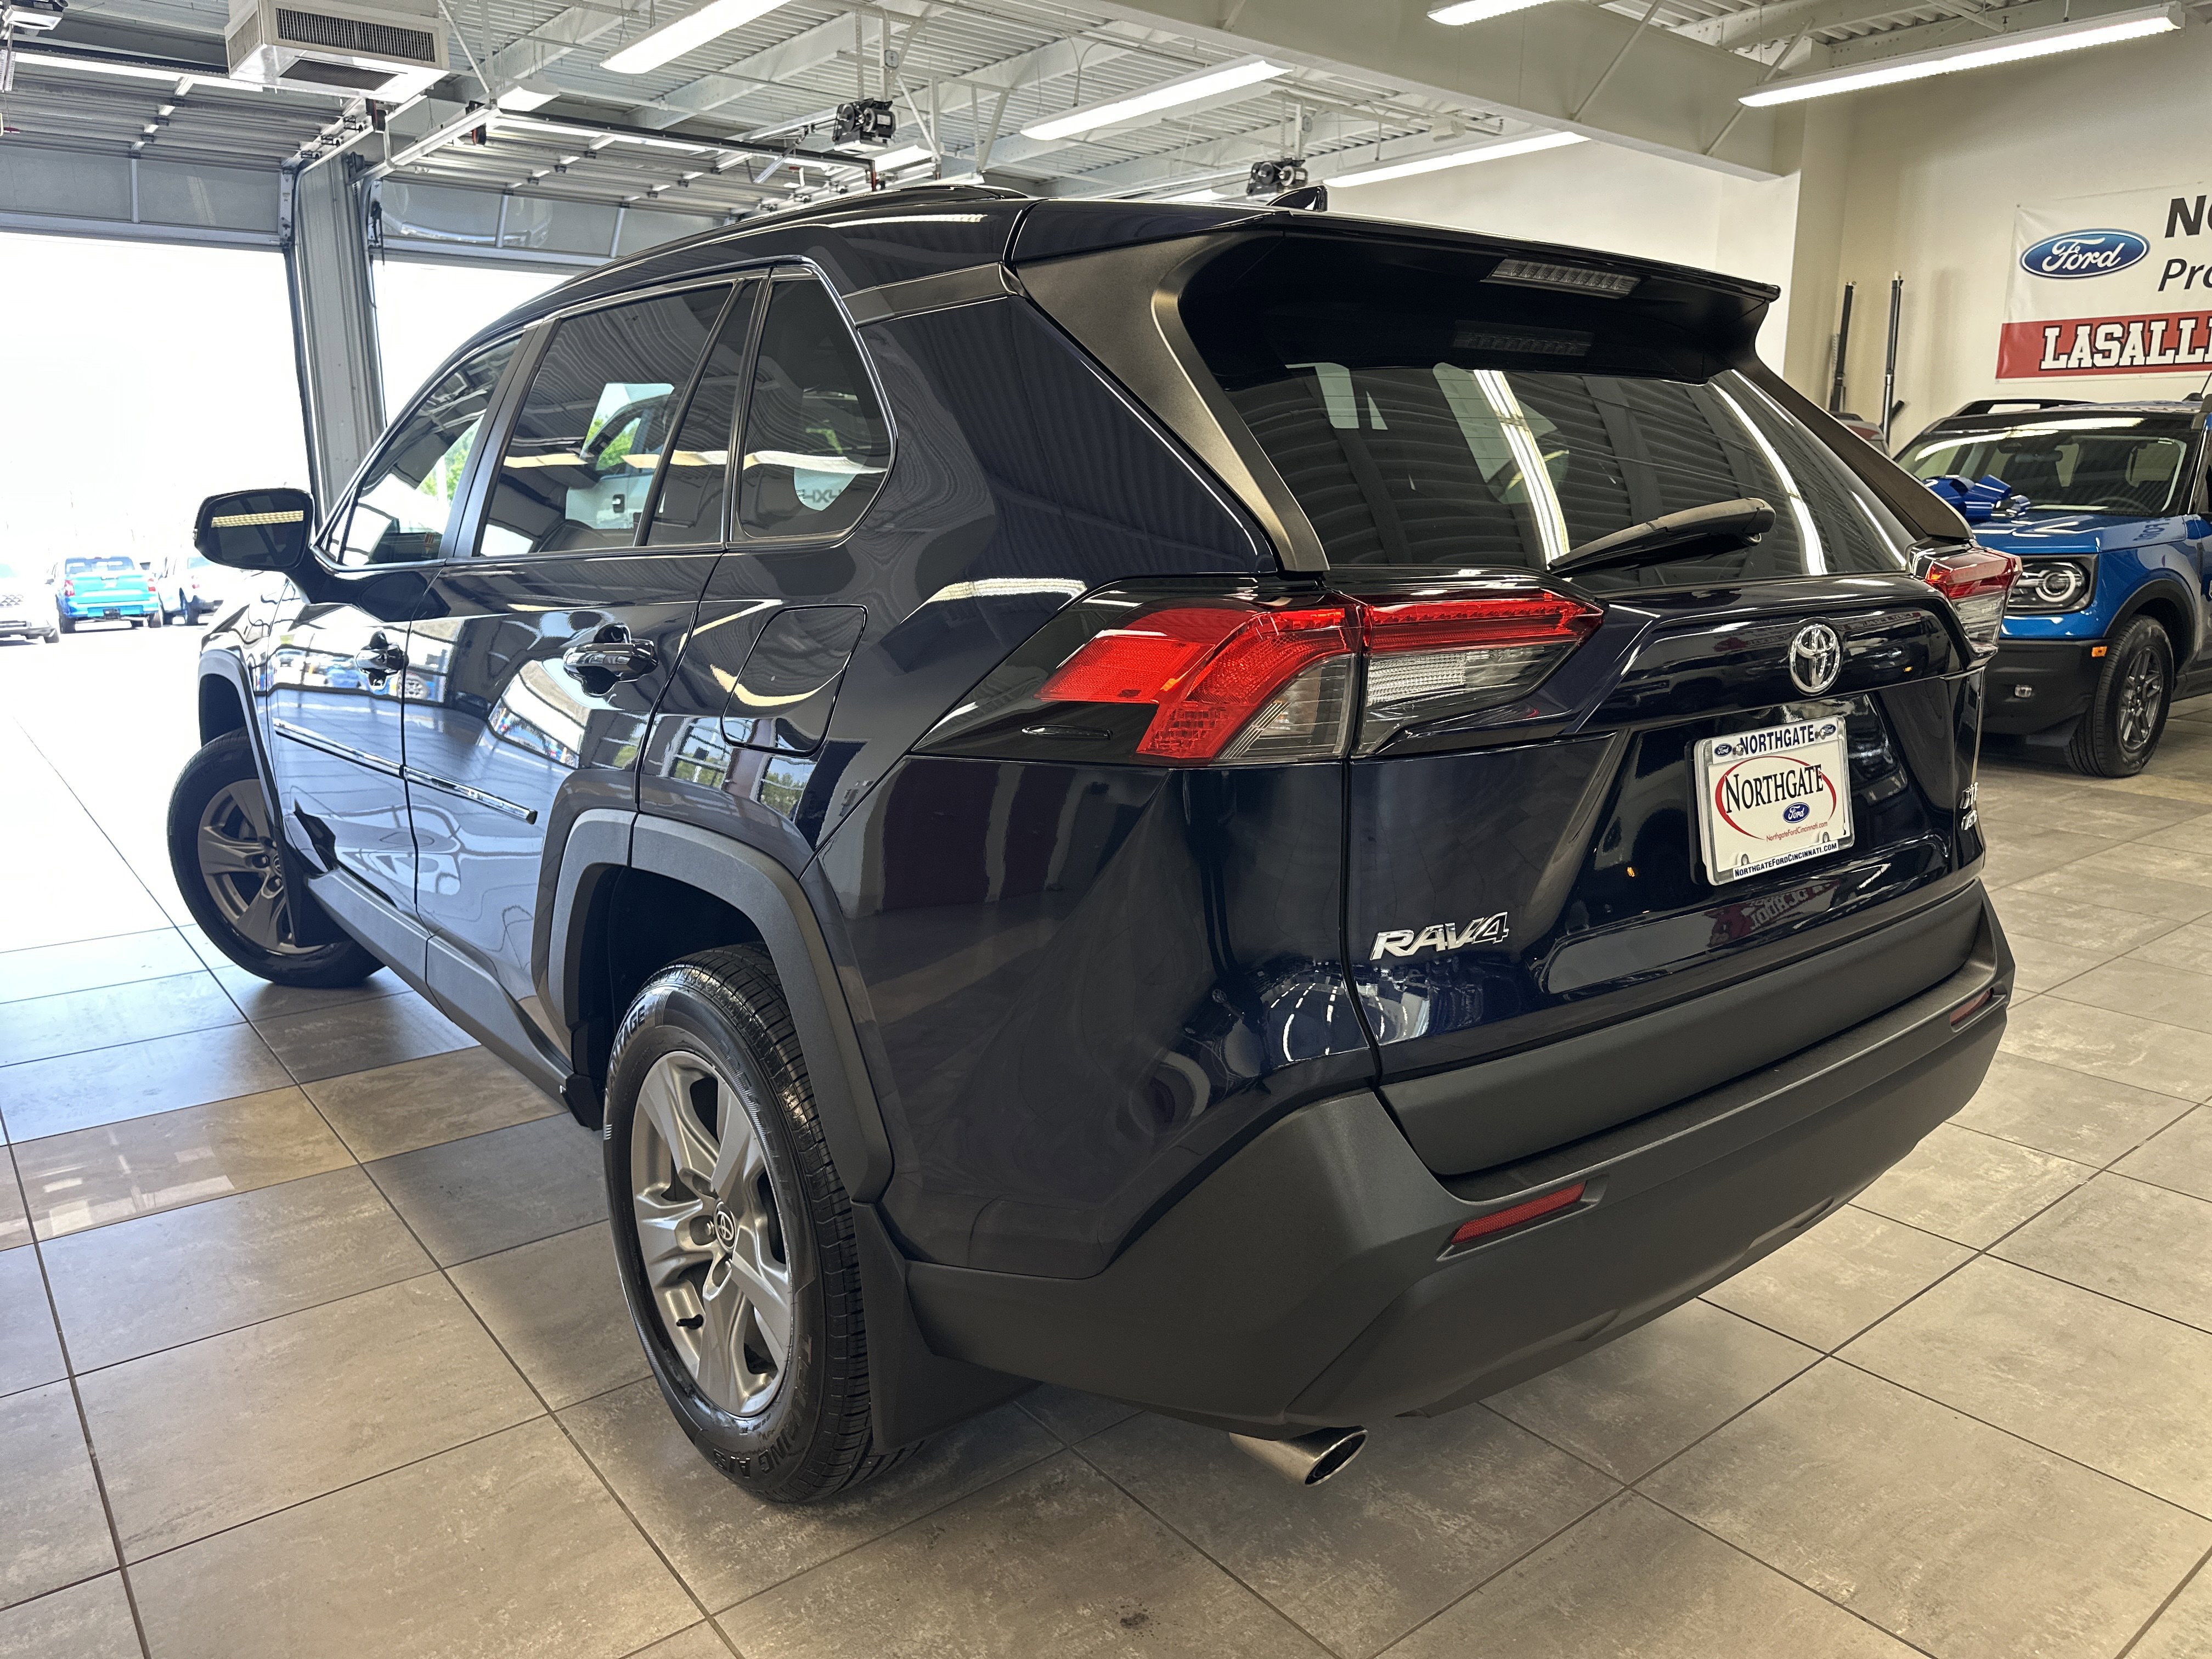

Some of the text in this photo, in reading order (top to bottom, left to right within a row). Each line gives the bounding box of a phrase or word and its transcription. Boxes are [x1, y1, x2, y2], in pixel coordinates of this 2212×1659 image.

[2165, 195, 2212, 238] N
[2042, 236, 2125, 272] Ford
[1740, 724, 1814, 755] NORTHGATE
[1725, 764, 1824, 814] NORTHGATE
[1787, 805, 1805, 820] Ford
[1369, 911, 1509, 960] RAV4
